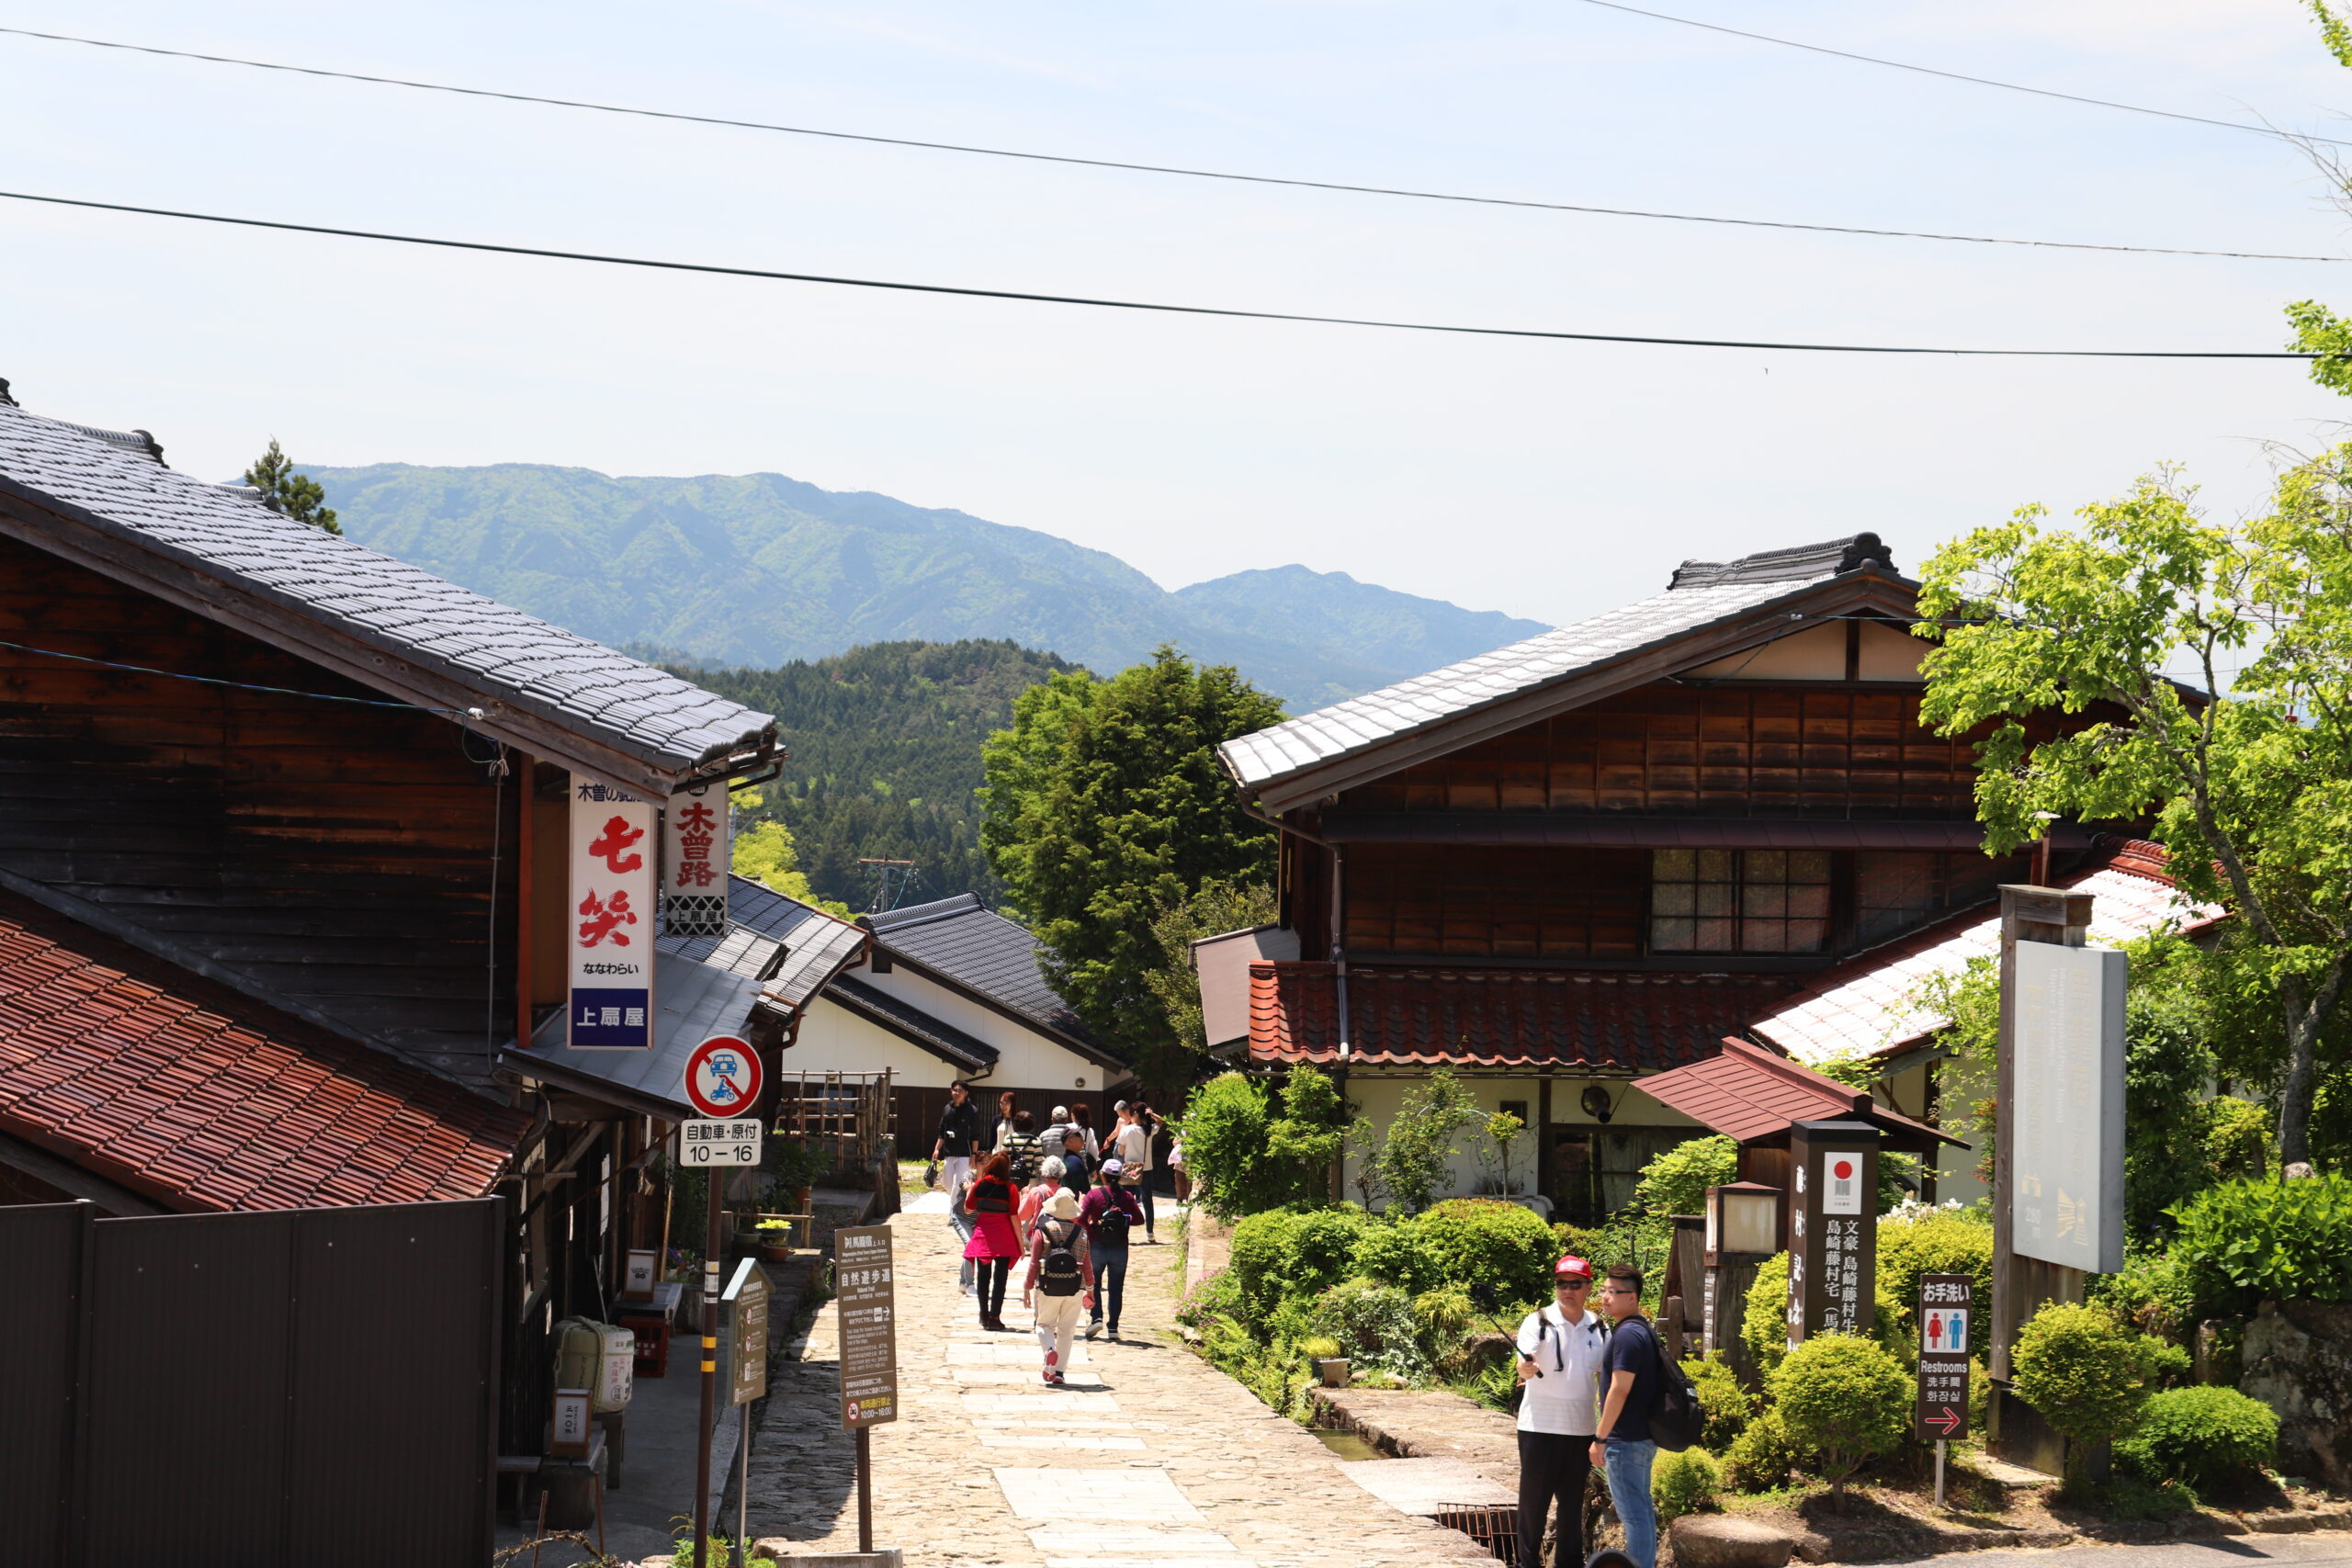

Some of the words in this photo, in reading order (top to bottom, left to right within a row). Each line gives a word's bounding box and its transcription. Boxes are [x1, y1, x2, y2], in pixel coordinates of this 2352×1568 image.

[578, 783, 642, 802] 木曽の
[582, 963, 639, 976] ななわらい
[576, 1006, 645, 1028] 上扇屋
[686, 1123, 757, 1140] 自動車・原付
[842, 1269, 891, 1287] 自然遊歩道
[1841, 1256, 1858, 1338] 島崎藤村生
[1923, 1282, 1970, 1303] お手洗い
[1921, 1359, 1968, 1373] Restrooms
[1926, 1391, 1961, 1403] 화장실
